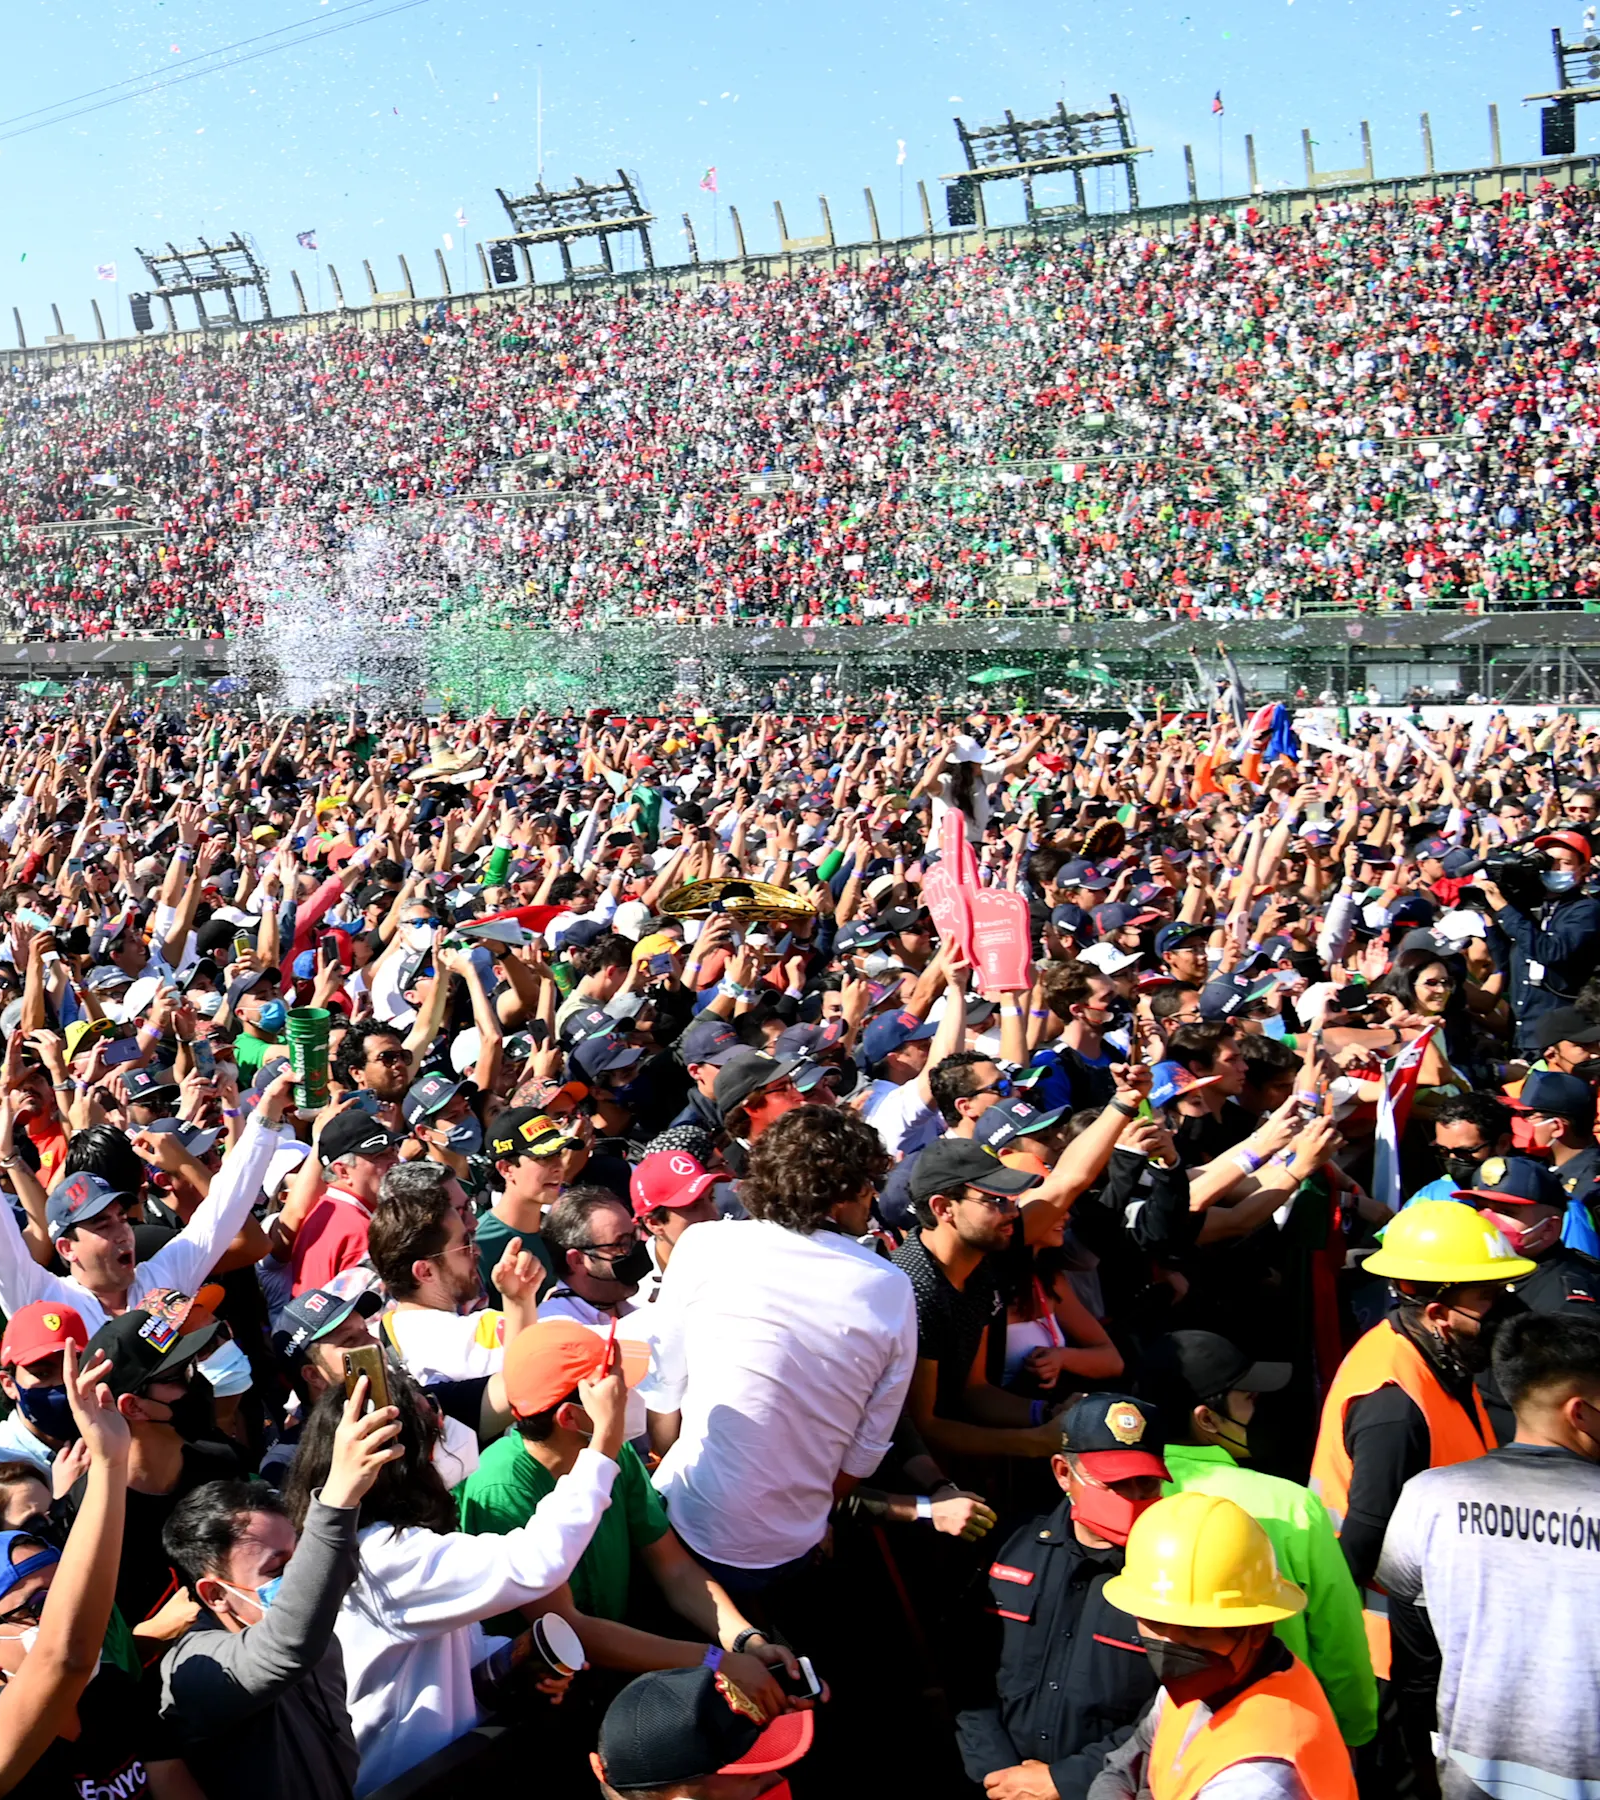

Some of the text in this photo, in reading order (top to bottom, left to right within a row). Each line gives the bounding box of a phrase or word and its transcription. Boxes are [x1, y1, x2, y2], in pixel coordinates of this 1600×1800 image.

[493, 1138, 514, 1154] 1ST
[304, 1293, 329, 1313] 11
[284, 1327, 309, 1357] KAVAK
[1457, 1501, 1600, 1551] PRODUCCIÓN
